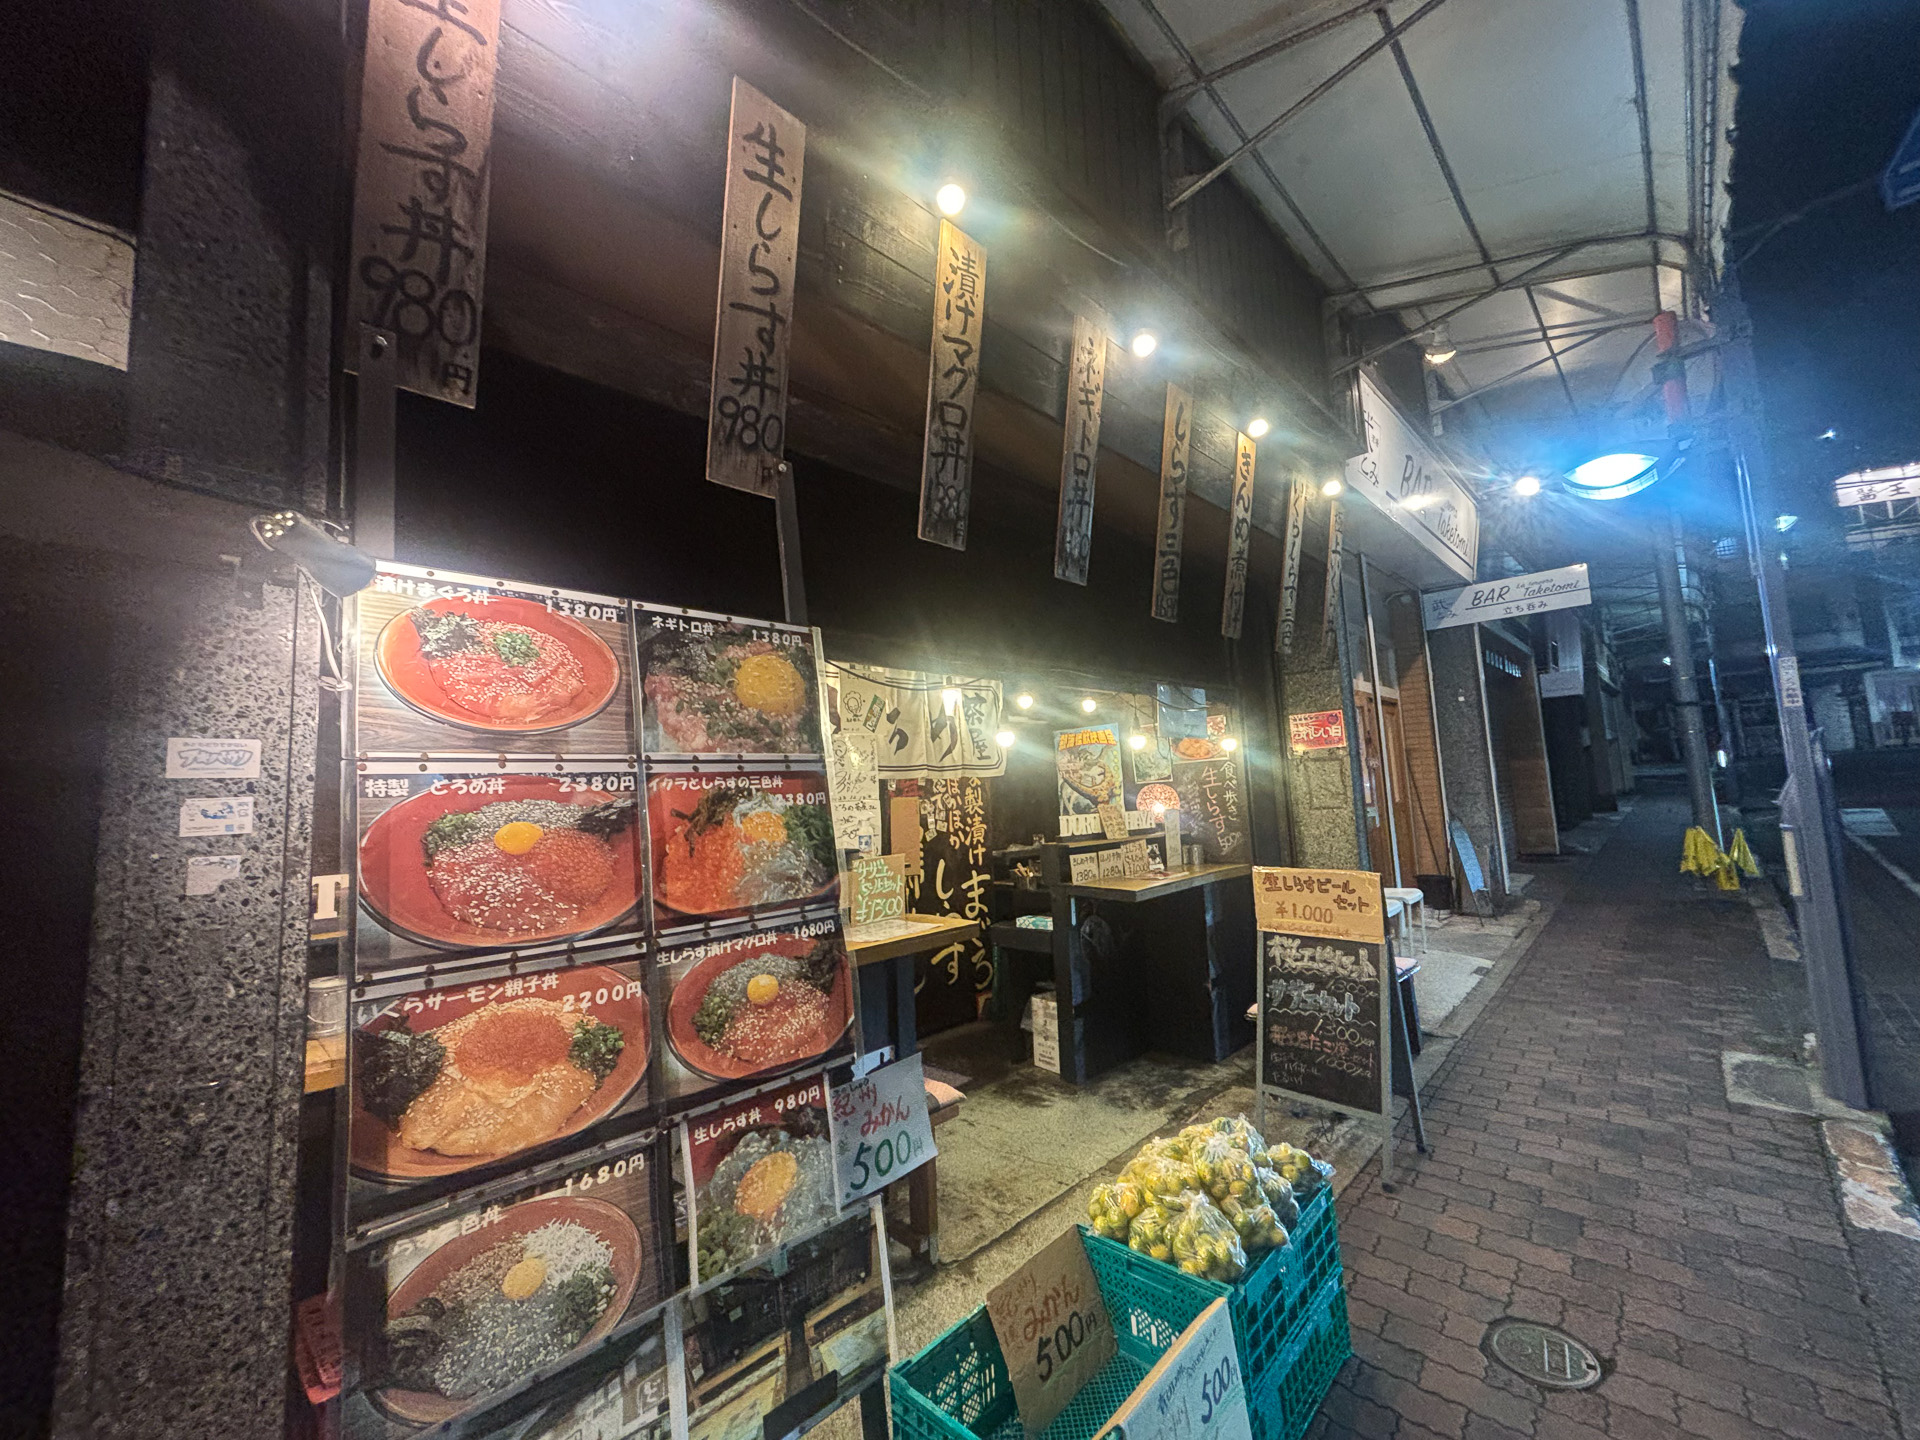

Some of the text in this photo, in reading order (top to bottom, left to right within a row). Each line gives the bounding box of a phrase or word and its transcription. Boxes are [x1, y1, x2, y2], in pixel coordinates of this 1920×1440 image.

[730, 122, 796, 404] 生しらす丼
[931, 246, 980, 481] 漬けマグロ丼
[1471, 585, 1511, 607] BAR
[1522, 580, 1580, 598] Taketomi
[546, 599, 618, 622] 1380円
[651, 615, 804, 648] ネギトロ丼 1380円
[364, 778, 410, 798] 特製
[558, 776, 636, 792] 2380円
[649, 775, 784, 792] イクラとしらすの三色丼
[1202, 766, 1227, 834] 生しらす
[1219, 761, 1238, 821] 食べ歩き
[1262, 872, 1357, 894] 生しらすビール
[1333, 895, 1370, 913] セット
[655, 918, 836, 967] 生しらす漬けマグロ丼 1680円
[355, 972, 560, 1022] いくらサーモン親子丼
[562, 980, 644, 1012] 2200円
[692, 1107, 763, 1146] 生しらす丼
[774, 1085, 821, 1115] 980円
[860, 1096, 910, 1137] みかん
[563, 1153, 647, 1197] 1680円
[1024, 1274, 1081, 1341] みかん
[1036, 1311, 1096, 1382] 500円
